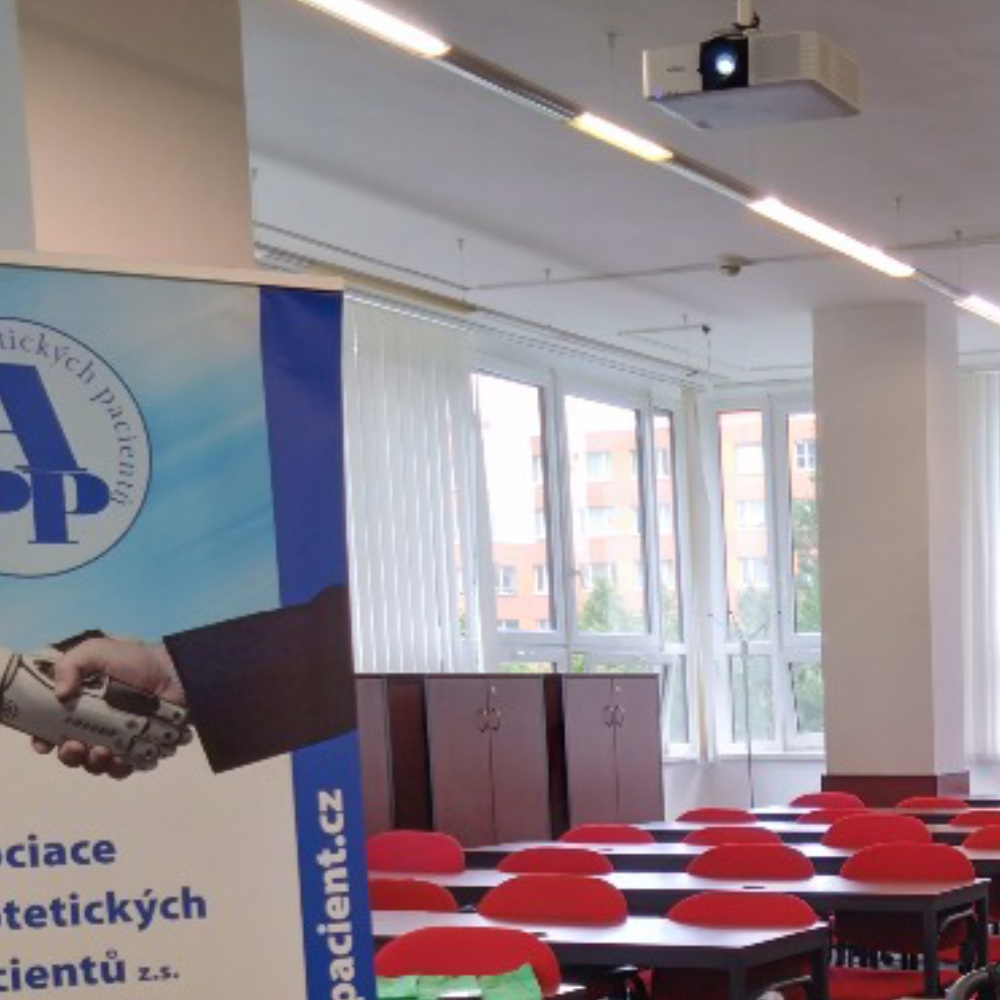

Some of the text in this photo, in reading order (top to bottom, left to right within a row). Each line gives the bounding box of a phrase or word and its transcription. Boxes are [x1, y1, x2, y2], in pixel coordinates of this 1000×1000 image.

[0, 833, 117, 868] ciace
[0, 886, 207, 932] tetických
[138, 965, 180, 982] z.s.
